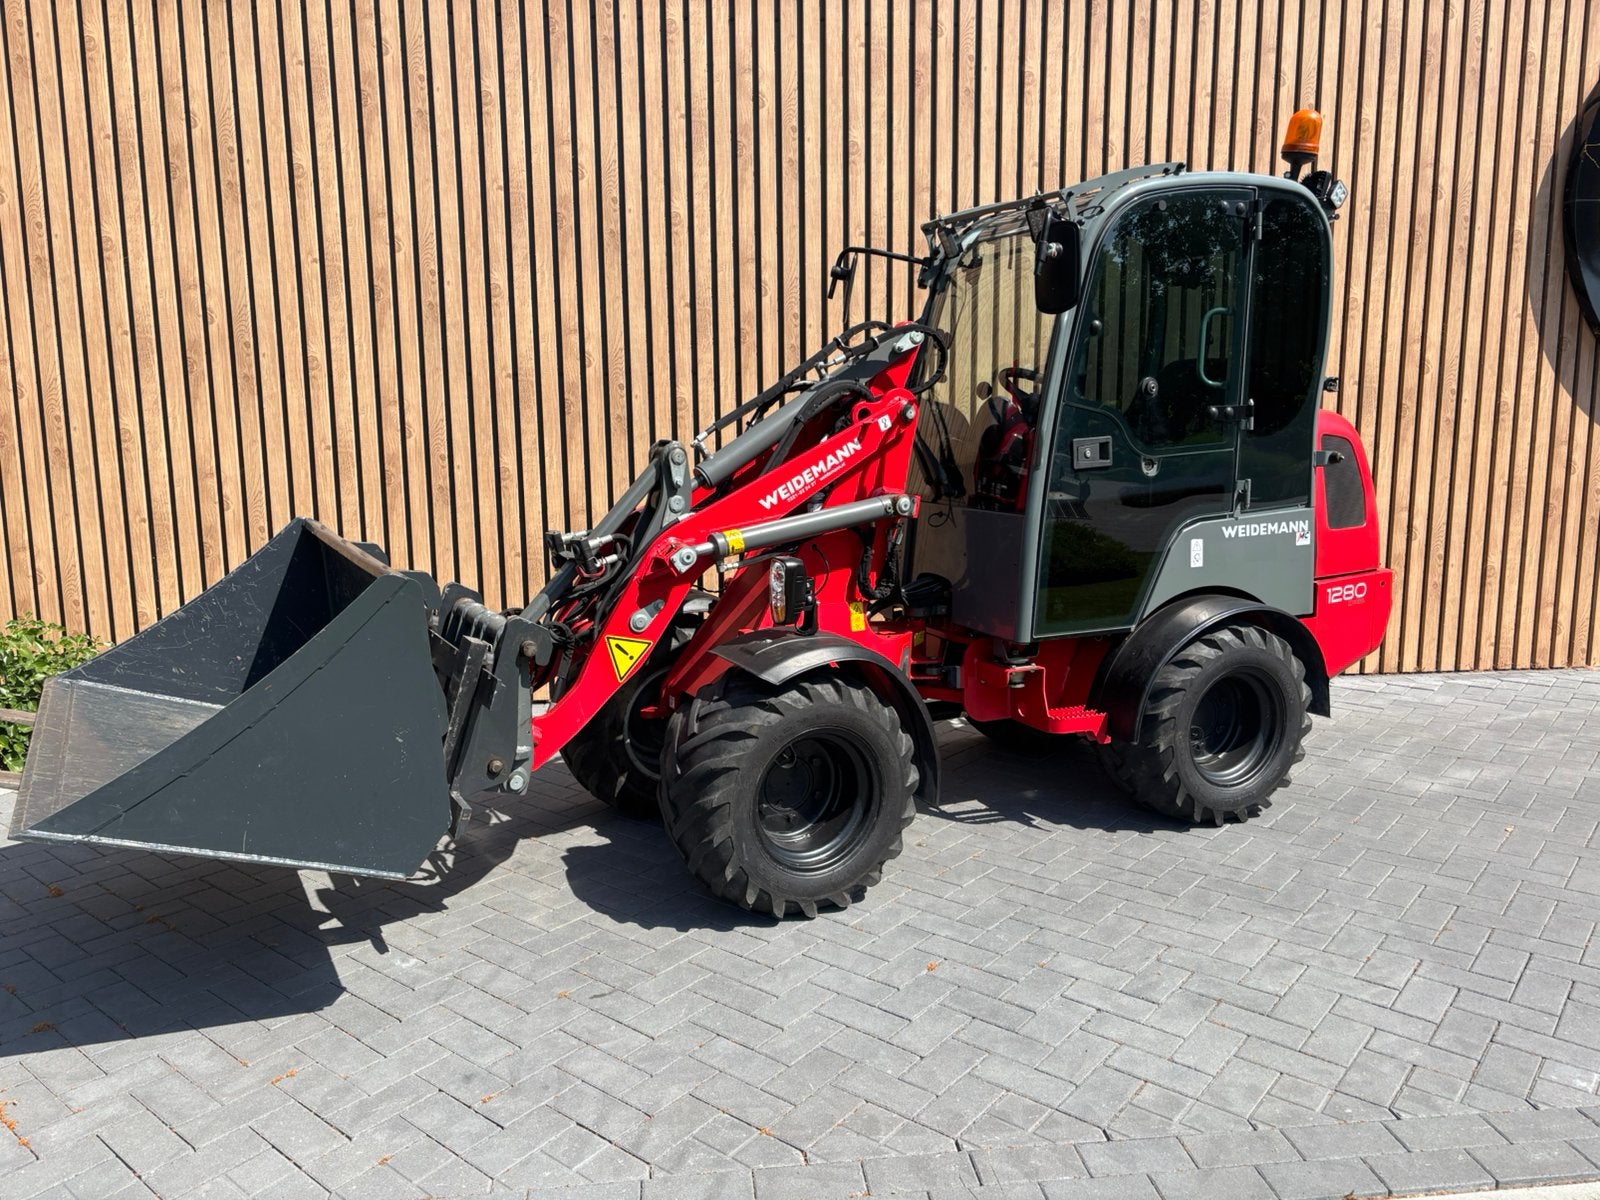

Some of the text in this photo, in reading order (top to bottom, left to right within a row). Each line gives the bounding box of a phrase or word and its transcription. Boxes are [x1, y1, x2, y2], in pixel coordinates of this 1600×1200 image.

[758, 437, 862, 510] WEIDEMANN
[1221, 520, 1309, 539] WEIDEMANN
[1326, 582, 1367, 604] 1280
